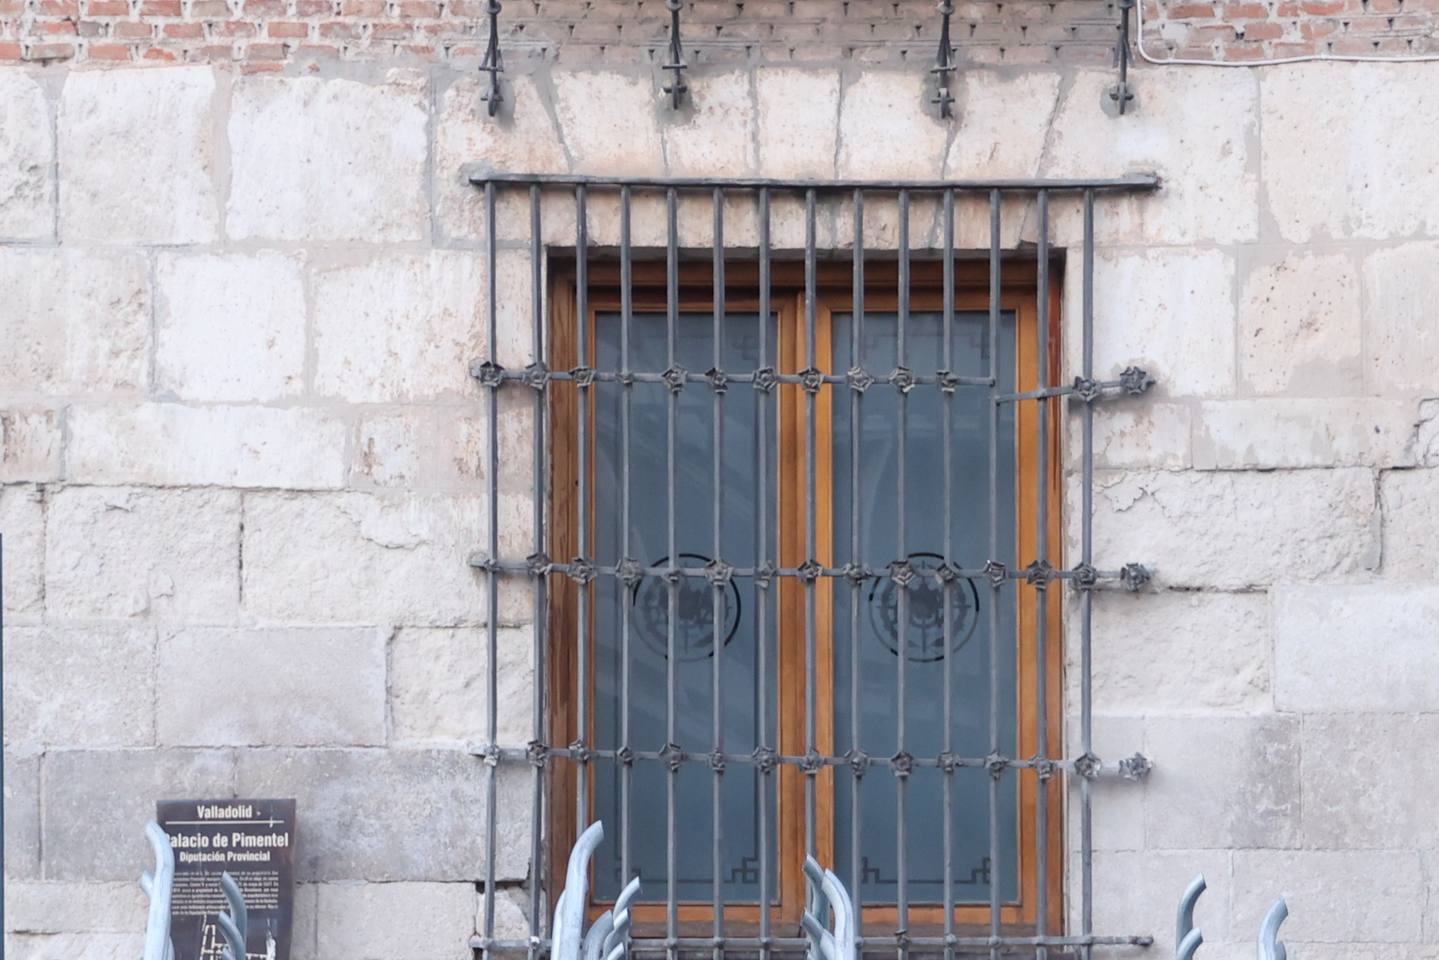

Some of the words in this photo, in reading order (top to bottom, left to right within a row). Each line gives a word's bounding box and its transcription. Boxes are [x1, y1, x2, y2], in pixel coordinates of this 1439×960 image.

[197, 805, 252, 819] Valladolid
[167, 833, 209, 847] alacio
[213, 833, 228, 847] de
[232, 832, 288, 847] Pimentel
[180, 851, 225, 863] Diputación
[227, 851, 270, 862] Provincial
